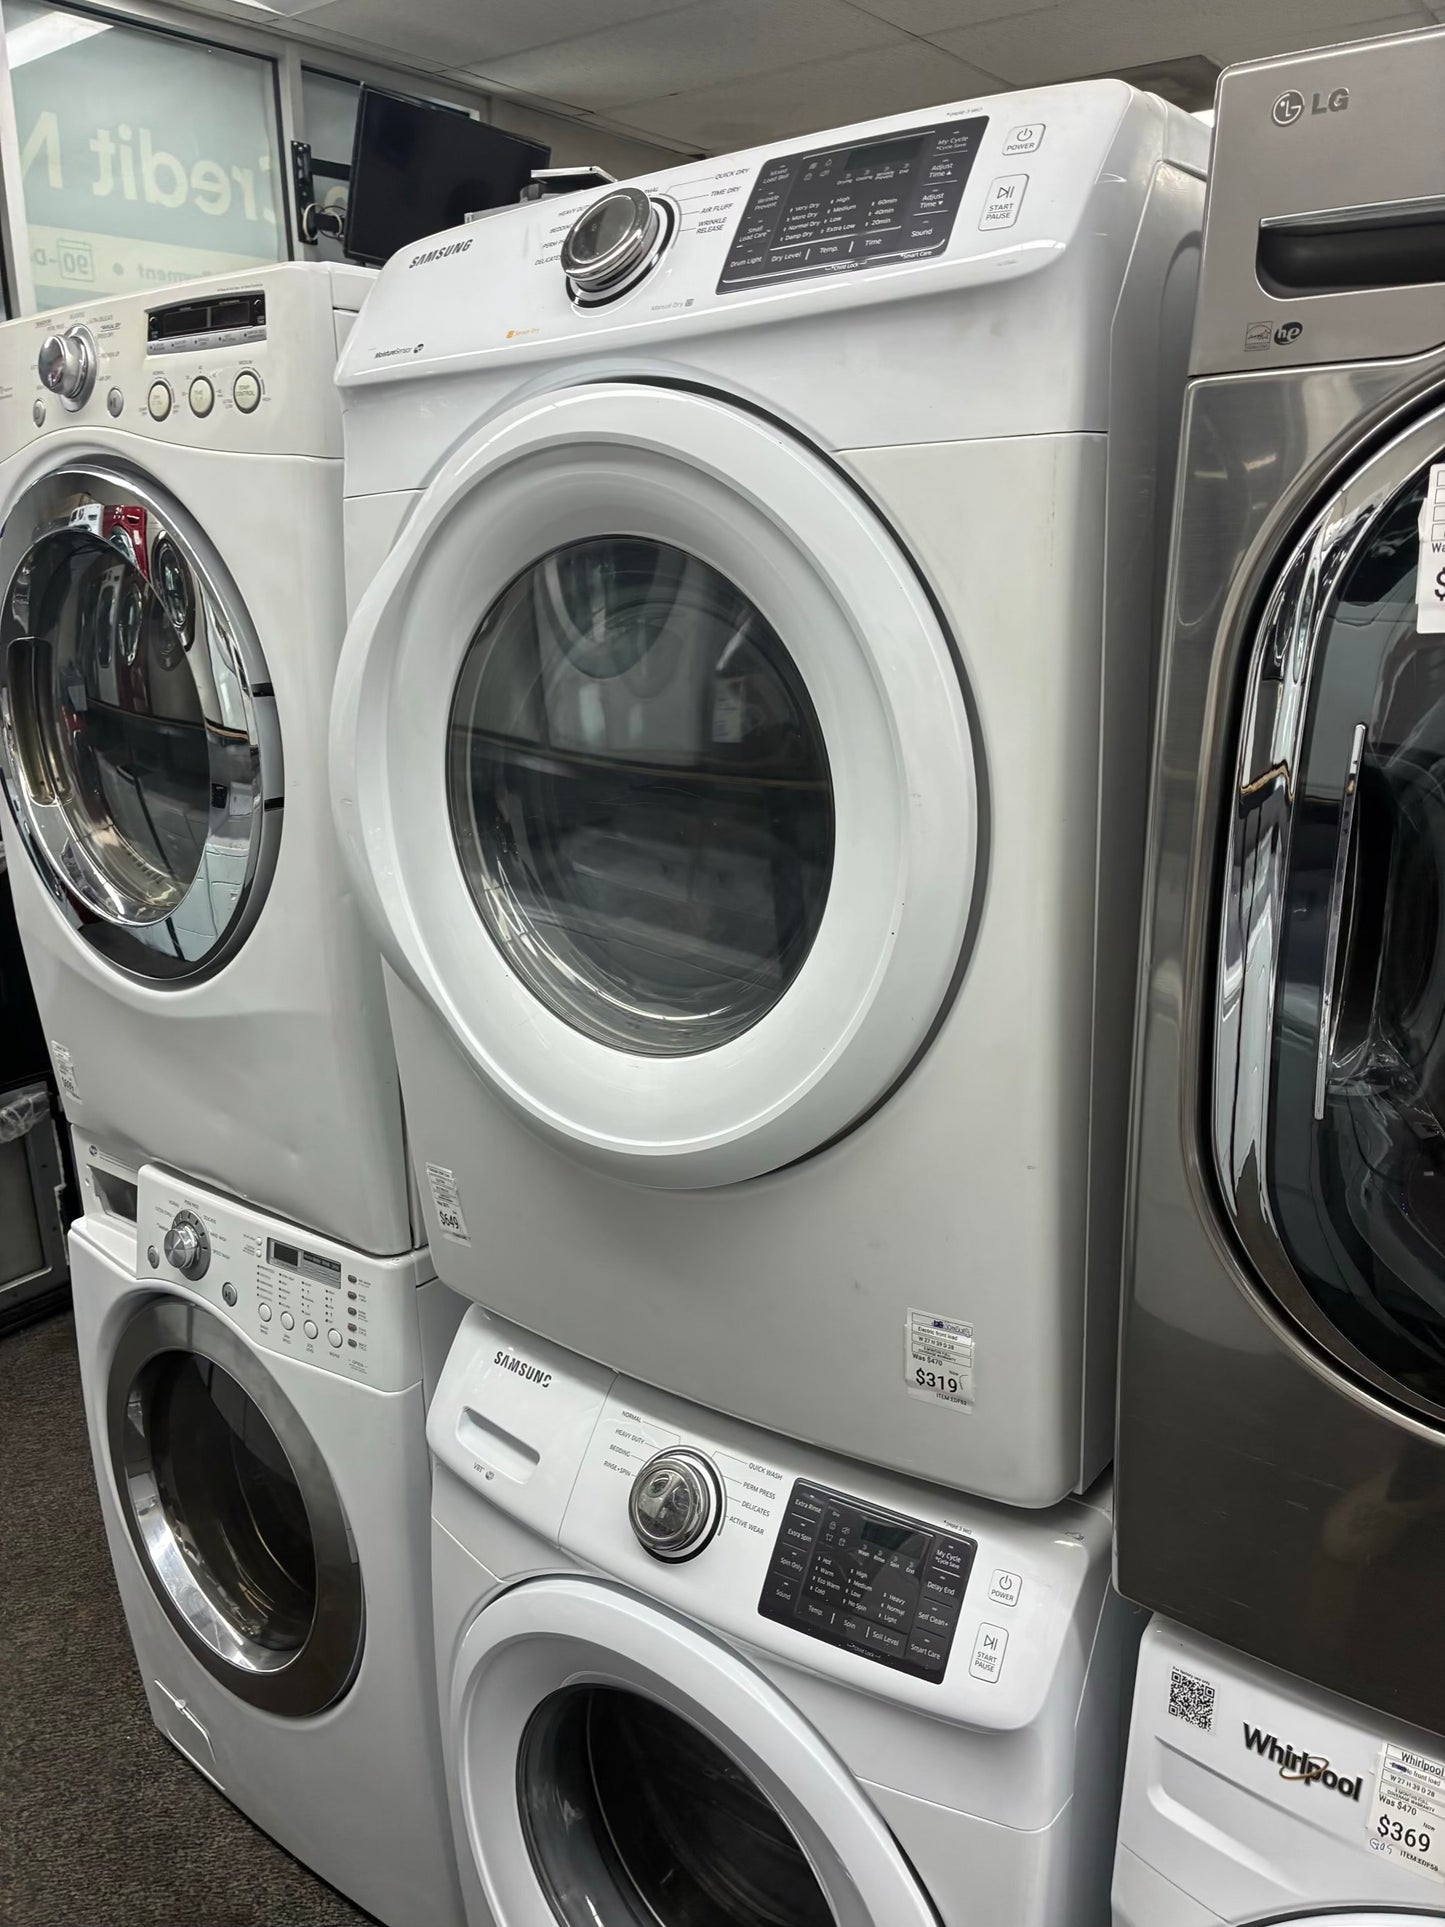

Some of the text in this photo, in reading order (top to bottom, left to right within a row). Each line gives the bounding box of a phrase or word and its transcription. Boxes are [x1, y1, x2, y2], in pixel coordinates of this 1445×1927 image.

[1311, 86, 1350, 115] LG
[938, 136, 968, 146] My Cycle
[1006, 142, 1035, 152] POWER
[931, 163, 953, 172] Adjust
[715, 171, 735, 180] QUICK
[763, 175, 778, 184] Load
[929, 171, 945, 179] Time
[710, 186, 742, 197] TIME DRY
[922, 192, 945, 202] Adjust
[809, 202, 821, 210] Dry
[877, 198, 898, 206] 60min
[919, 201, 937, 209] Time
[988, 203, 1014, 211] START
[700, 203, 734, 214] AIR FLUFF
[833, 205, 857, 213] Medium
[874, 208, 895, 216] 40min
[698, 216, 728, 227] WRINKLE
[791, 214, 807, 222] More
[986, 211, 1011, 221] PAUSE
[788, 220, 821, 231] Normal Dry
[870, 218, 892, 226] 20min
[549, 224, 573, 234] BEDDIN
[696, 224, 725, 234] RELEASE
[747, 225, 764, 234] Small
[911, 228, 933, 237] Sound
[739, 233, 754, 243] Load
[784, 233, 802, 241] Damp
[865, 239, 883, 247] Time
[408, 239, 474, 269] SAMSUNG
[771, 251, 802, 263] Dry Level
[920, 249, 933, 257] Care
[730, 256, 763, 268] Drum Light
[912, 1352, 943, 1367] Was $470
[494, 1351, 552, 1388] SAMSUNG
[915, 1367, 958, 1393] $319
[621, 1410, 642, 1423] NORMAL
[615, 1428, 645, 1444] HEAVY DUTY
[609, 1444, 631, 1457] BEDDING
[748, 1462, 783, 1480] QUICK WASH
[742, 1481, 776, 1500] PERM PRESS
[741, 1500, 771, 1517] DELICATES
[794, 1499, 808, 1509] Extra
[808, 1504, 822, 1514] Rinse
[729, 1516, 765, 1535] ACTIVE WEAR
[787, 1528, 813, 1543] Extra Spin
[822, 1557, 832, 1566] Hot
[873, 1554, 886, 1563] Rinse
[936, 1549, 962, 1563] My Cycle
[780, 1556, 803, 1572] Spin Only
[949, 1561, 960, 1570] Save
[820, 1567, 835, 1577] Warm
[855, 1570, 868, 1579] High
[817, 1576, 841, 1591] Eco Warm
[853, 1580, 873, 1592] Medium
[927, 1581, 956, 1596] Delay End
[775, 1589, 791, 1600] Sound
[814, 1587, 826, 1596] Cold
[850, 1590, 862, 1598] Low
[991, 1589, 1015, 1602] POWER
[848, 1599, 868, 1612] No Spin
[889, 1594, 906, 1606] Heavy
[886, 1604, 905, 1616] Normal
[884, 1614, 898, 1624] Light
[917, 1611, 929, 1623] Self
[843, 1619, 856, 1630] Spin
[872, 1631, 900, 1646] Soil Level
[910, 1643, 941, 1660] Smart Care
[977, 1651, 997, 1664] START
[974, 1660, 995, 1673] PAUSE
[1242, 1721, 1364, 1802] Whirlpool
[1401, 1751, 1445, 1777] Whirlpool
[1413, 1770, 1441, 1787] front load
[1389, 1774, 1397, 1782] W
[1397, 1776, 1405, 1784] 27
[1412, 1781, 1420, 1791] 39
[1426, 1788, 1435, 1798] 28
[1379, 1794, 1417, 1816] Was $470
[1377, 1814, 1431, 1853] $369
